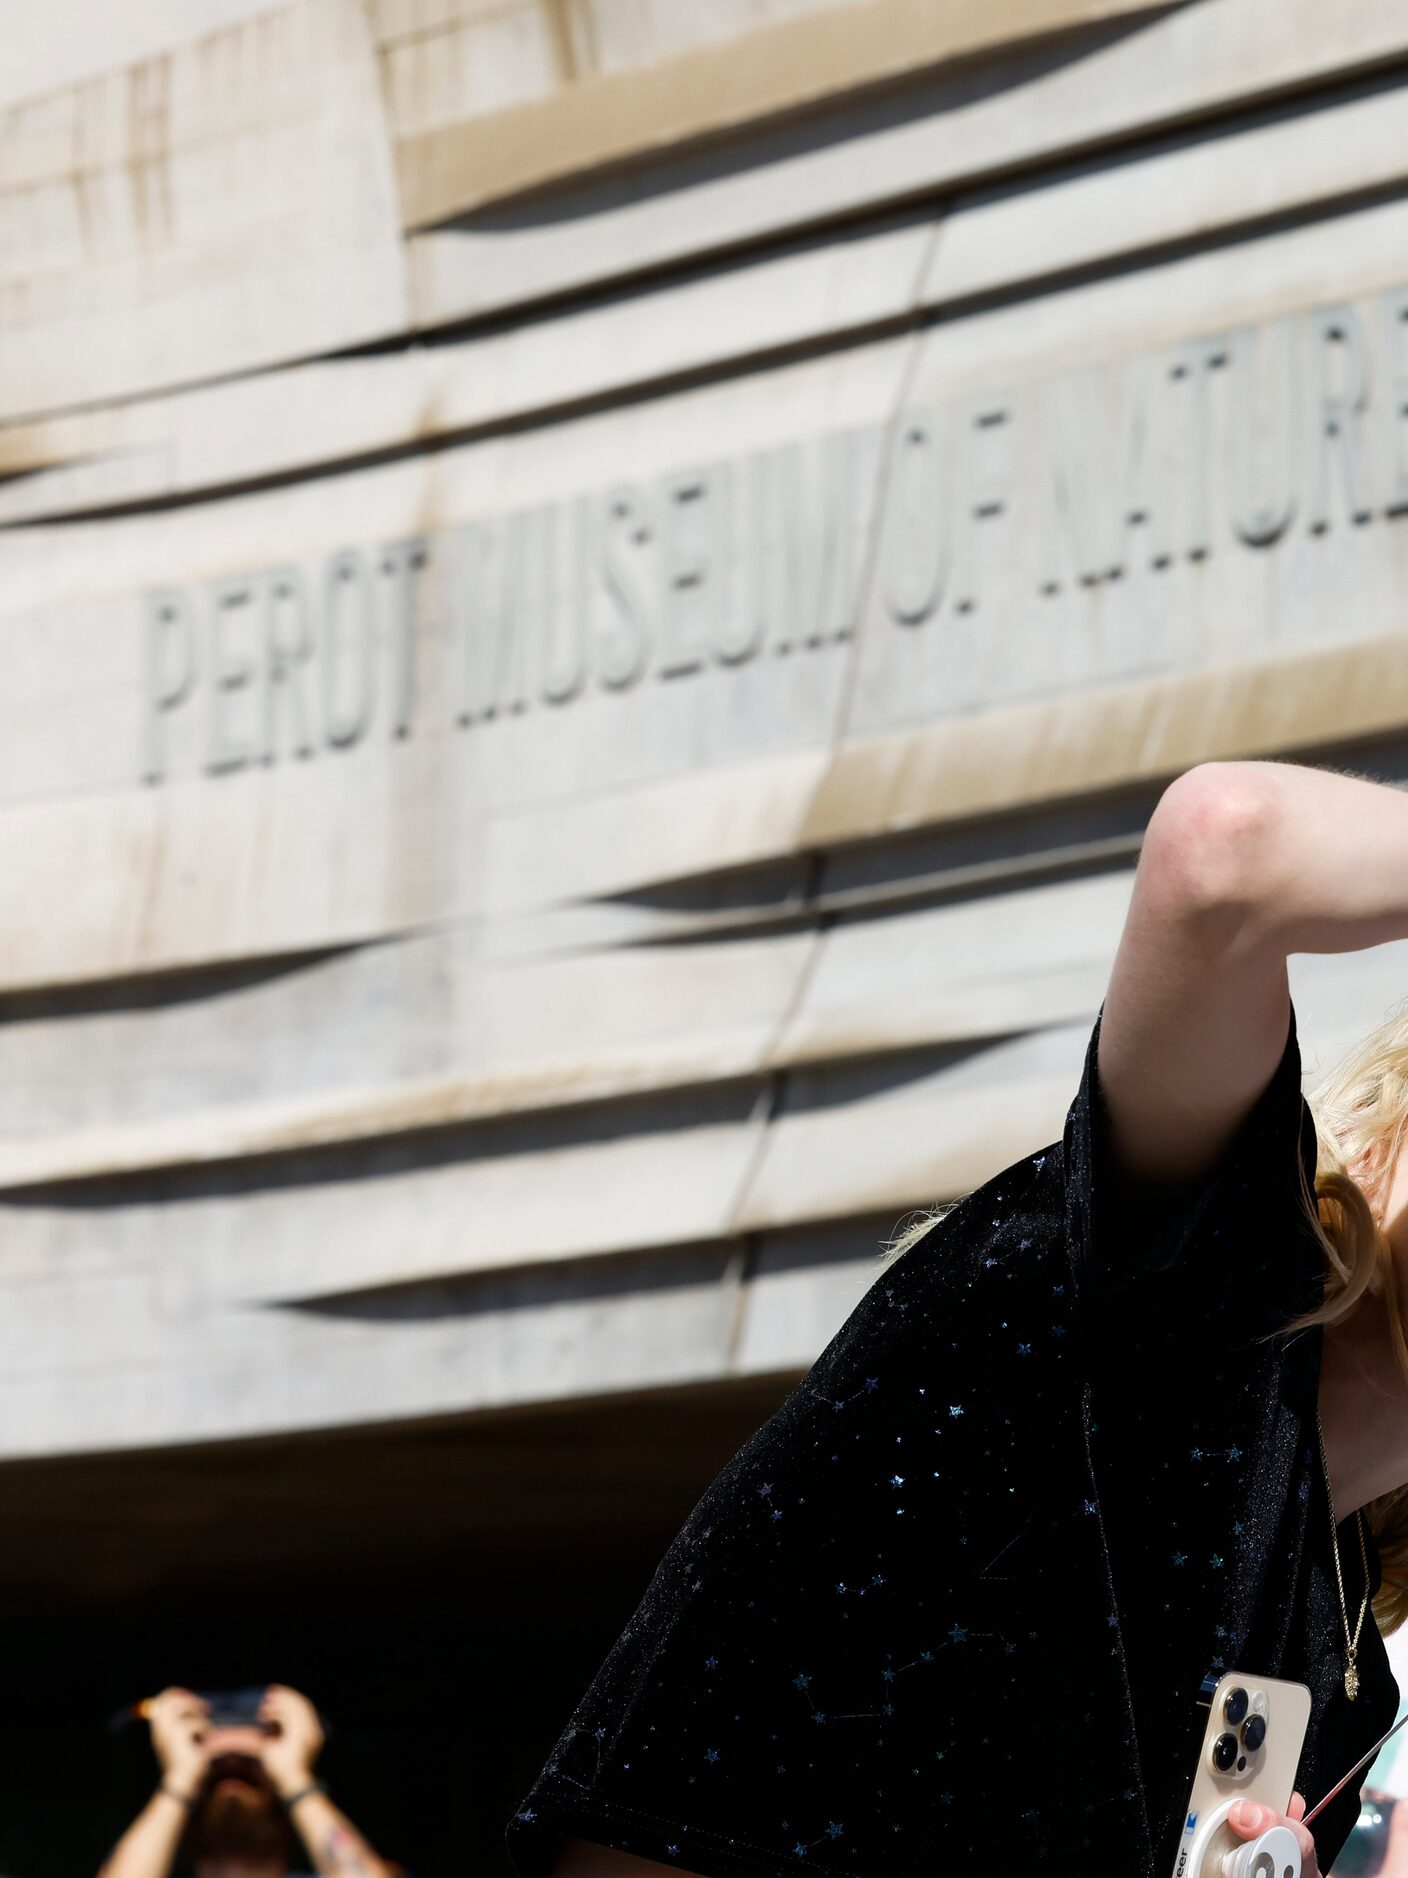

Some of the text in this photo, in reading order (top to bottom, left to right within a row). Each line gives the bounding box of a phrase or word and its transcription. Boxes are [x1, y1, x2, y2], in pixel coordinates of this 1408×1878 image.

[140, 535, 428, 788] PEROT
[453, 424, 876, 730] MUSEUM
[880, 386, 1010, 630] OF
[1176, 1848, 1188, 1878] eer
